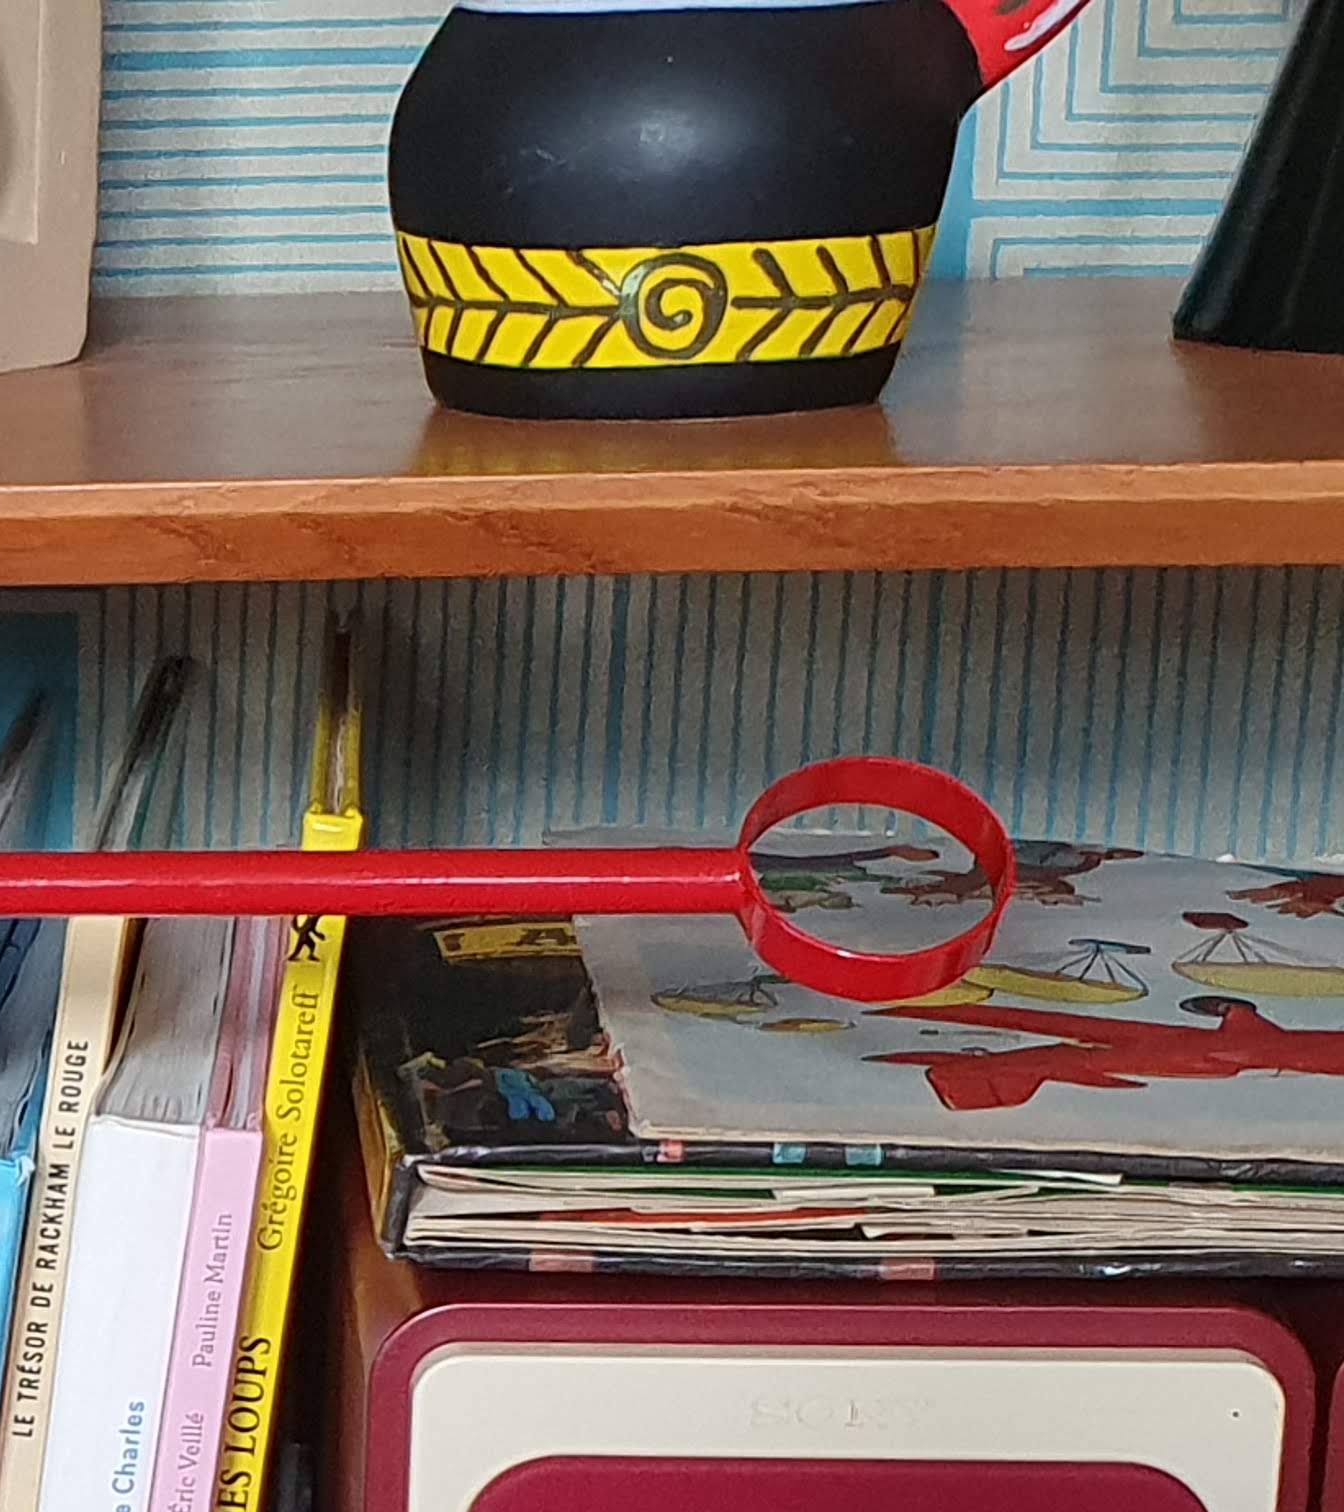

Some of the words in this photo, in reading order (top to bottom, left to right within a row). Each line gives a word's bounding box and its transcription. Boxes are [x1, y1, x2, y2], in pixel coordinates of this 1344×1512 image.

[56, 1038, 89, 1113] ROUGE
[271, 984, 322, 1123] Solotareff
[51, 1124, 75, 1151] LE
[34, 1160, 71, 1271] RACKHAM
[253, 1131, 306, 1254] Grégoire
[203, 1211, 233, 1284] Martin
[29, 1281, 53, 1307] DE
[190, 1288, 221, 1368] Pauline
[13, 1319, 47, 1403] TRÉSOR
[222, 1333, 271, 1456] LOUPS
[11, 1413, 35, 1438] LE
[111, 1402, 146, 1495] Charles
